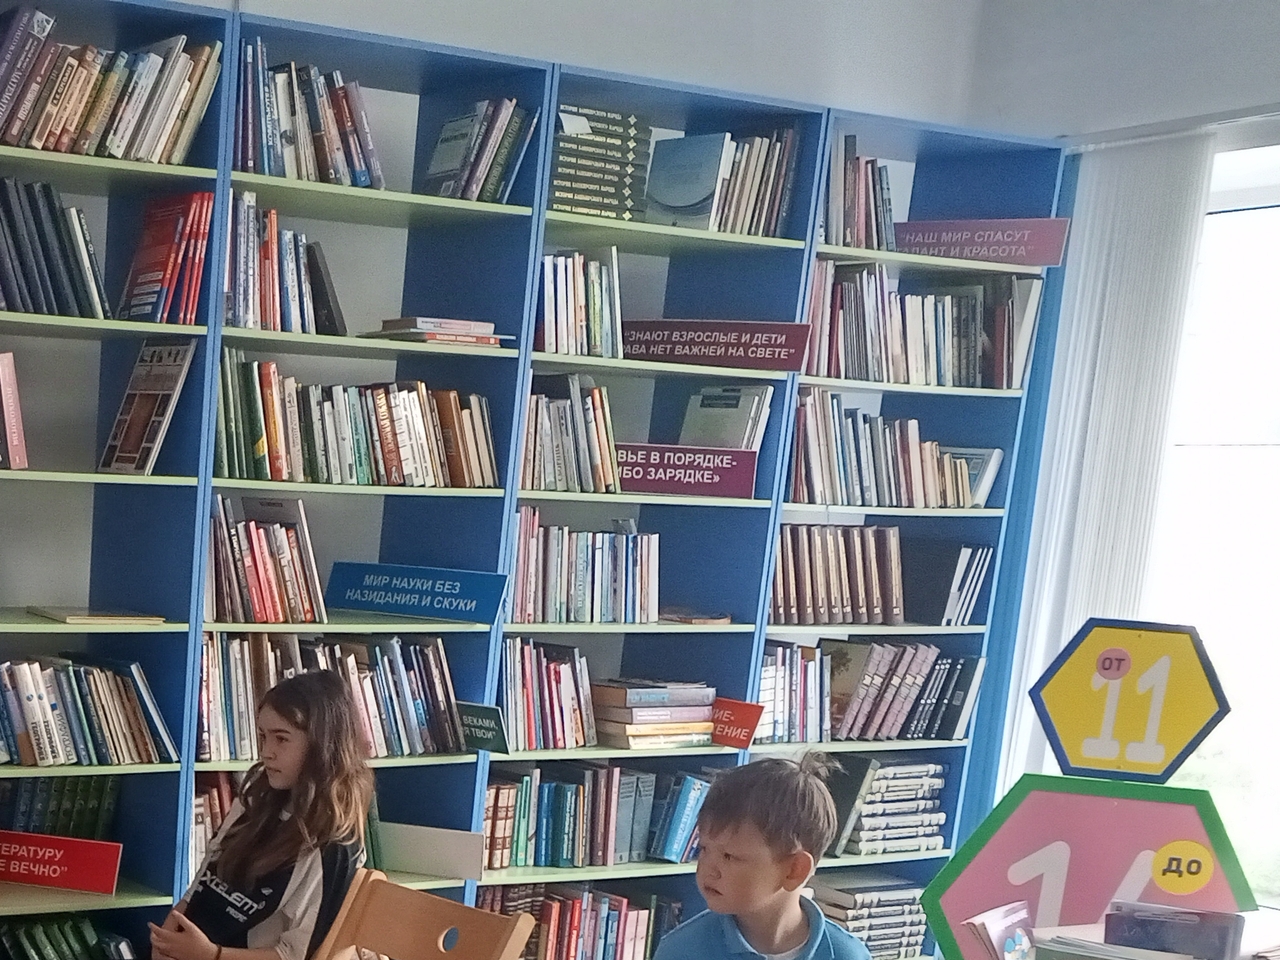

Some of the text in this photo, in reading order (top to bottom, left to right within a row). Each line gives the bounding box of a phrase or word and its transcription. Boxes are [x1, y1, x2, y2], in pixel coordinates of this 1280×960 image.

[940, 231, 971, 242] МИР
[974, 230, 1032, 242] СПАСУТ
[949, 246, 960, 256] И
[672, 331, 738, 343] ВЗРОСЛЫЕ
[741, 333, 751, 343] И
[752, 333, 787, 345] ДЕТИ
[650, 344, 672, 355] НЕТ
[674, 344, 726, 356] ВАЖНЕЙ
[727, 347, 745, 357] НА
[617, 450, 647, 463] ВЬЕ
[650, 451, 660, 464] В
[363, 574, 461, 594] МИР НАУКИ БЕЗ
[345, 588, 477, 612] НАЗИДАНИЯ И СКУКИ
[1101, 655, 1125, 673] ОТ
[1081, 655, 1172, 763] 11
[1162, 854, 1204, 878] ДО
